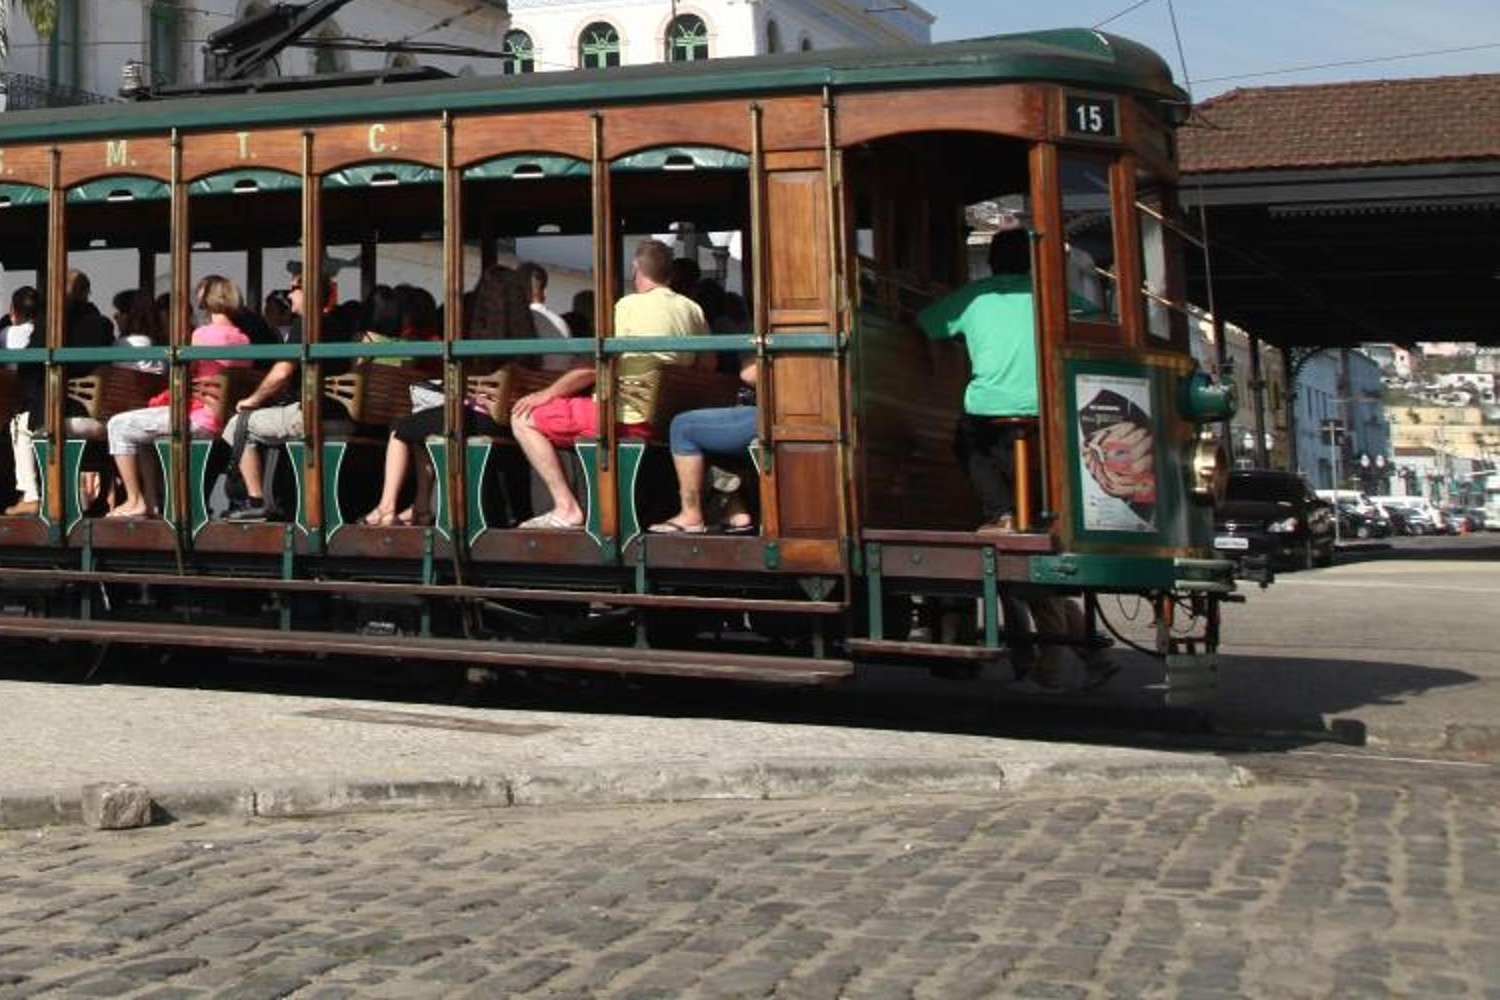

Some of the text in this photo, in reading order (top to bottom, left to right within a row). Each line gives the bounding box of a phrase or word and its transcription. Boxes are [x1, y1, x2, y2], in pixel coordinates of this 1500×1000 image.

[1076, 104, 1102, 132] 15
[106, 140, 137, 167] M.
[368, 123, 398, 153] C.
